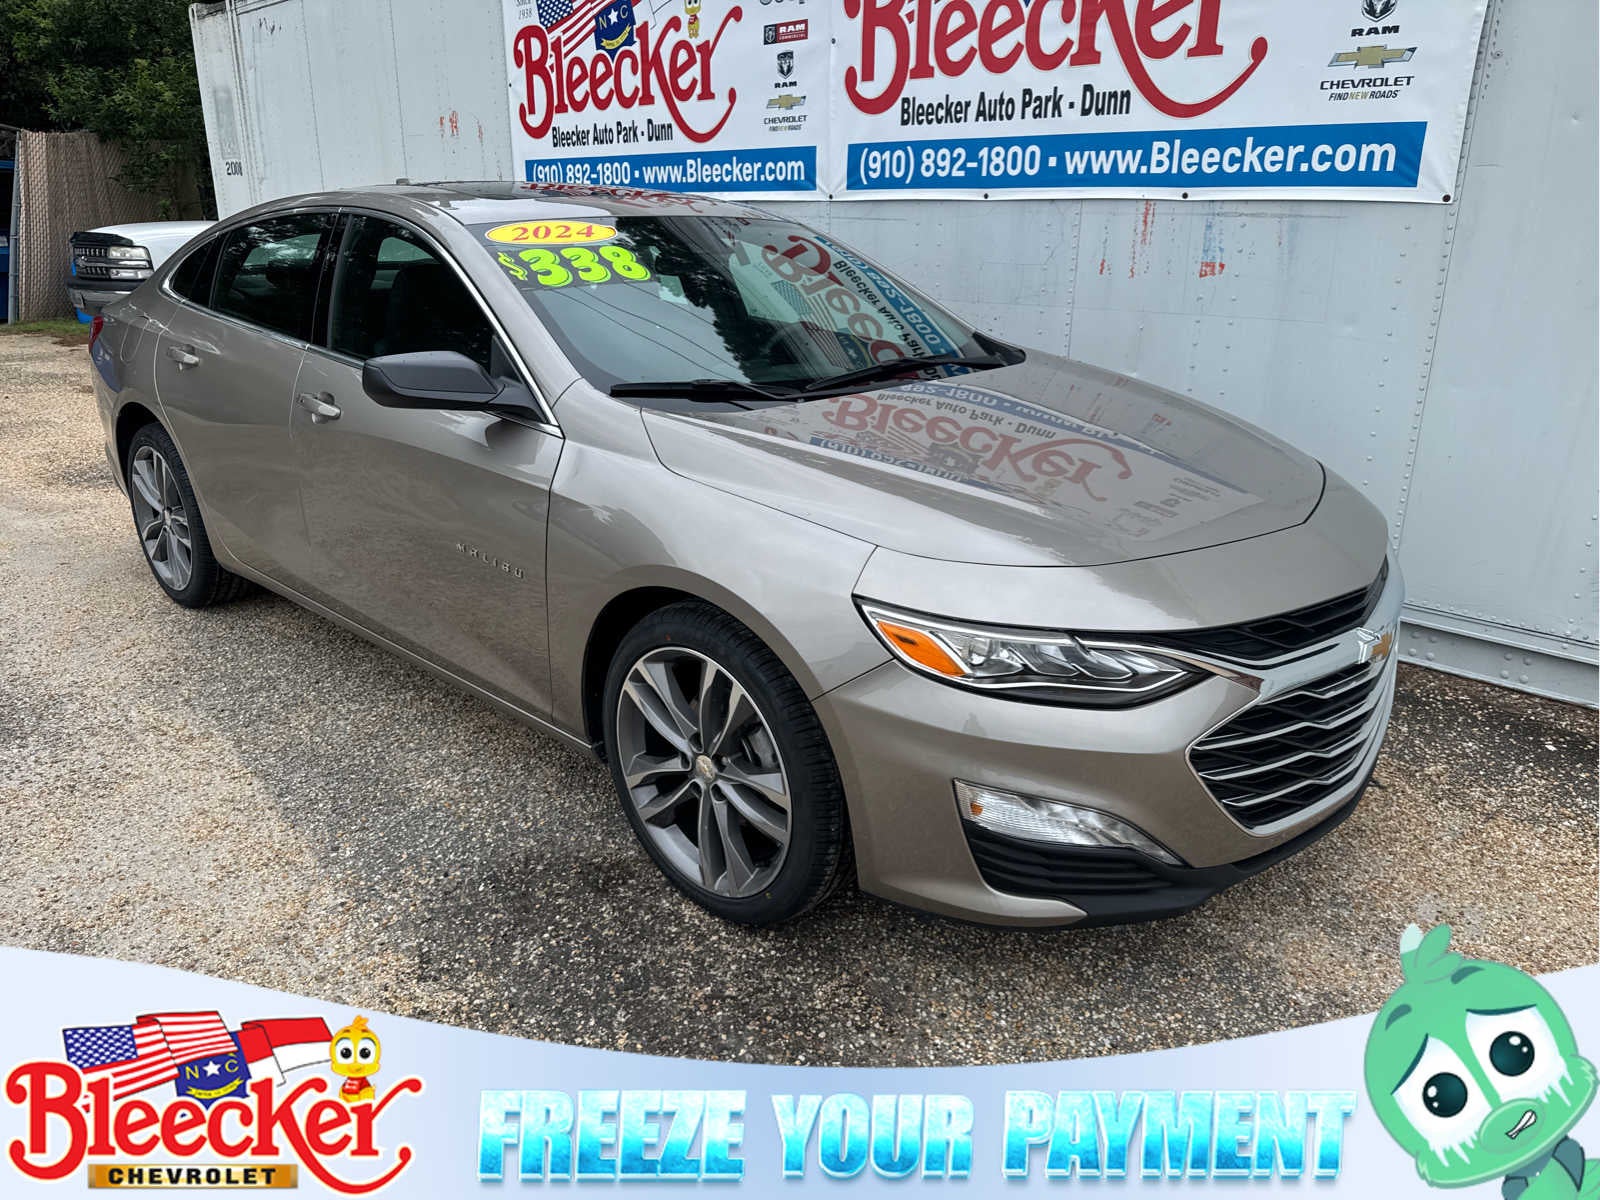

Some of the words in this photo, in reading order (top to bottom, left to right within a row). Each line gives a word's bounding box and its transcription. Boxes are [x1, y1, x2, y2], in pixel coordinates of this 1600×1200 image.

[779, 23, 806, 33] RAM
[1351, 25, 1400, 37] RAM
[513, 6, 743, 143] Bleecker
[1320, 76, 1415, 90] CHEVROLET
[774, 81, 797, 89] RAM
[900, 95, 971, 127] Bleecker
[975, 91, 1016, 123] Auto
[1021, 86, 1063, 120] Park
[1081, 83, 1131, 117] Dunn
[1328, 92, 1349, 102] FIND
[763, 115, 807, 124] CHEVROLET
[552, 125, 590, 148] Bleecker
[593, 121, 614, 146] Auto
[617, 119, 638, 144] Park
[647, 118, 673, 142] Dunn
[860, 145, 914, 184] (910)
[921, 144, 1040, 177] 892-1800
[1064, 136, 1396, 175] www.Bleecker.com
[566, 161, 631, 185] 892-1800
[643, 156, 804, 184] www.Bleecker.com
[511, 224, 596, 241] 2024
[497, 245, 651, 288] $338
